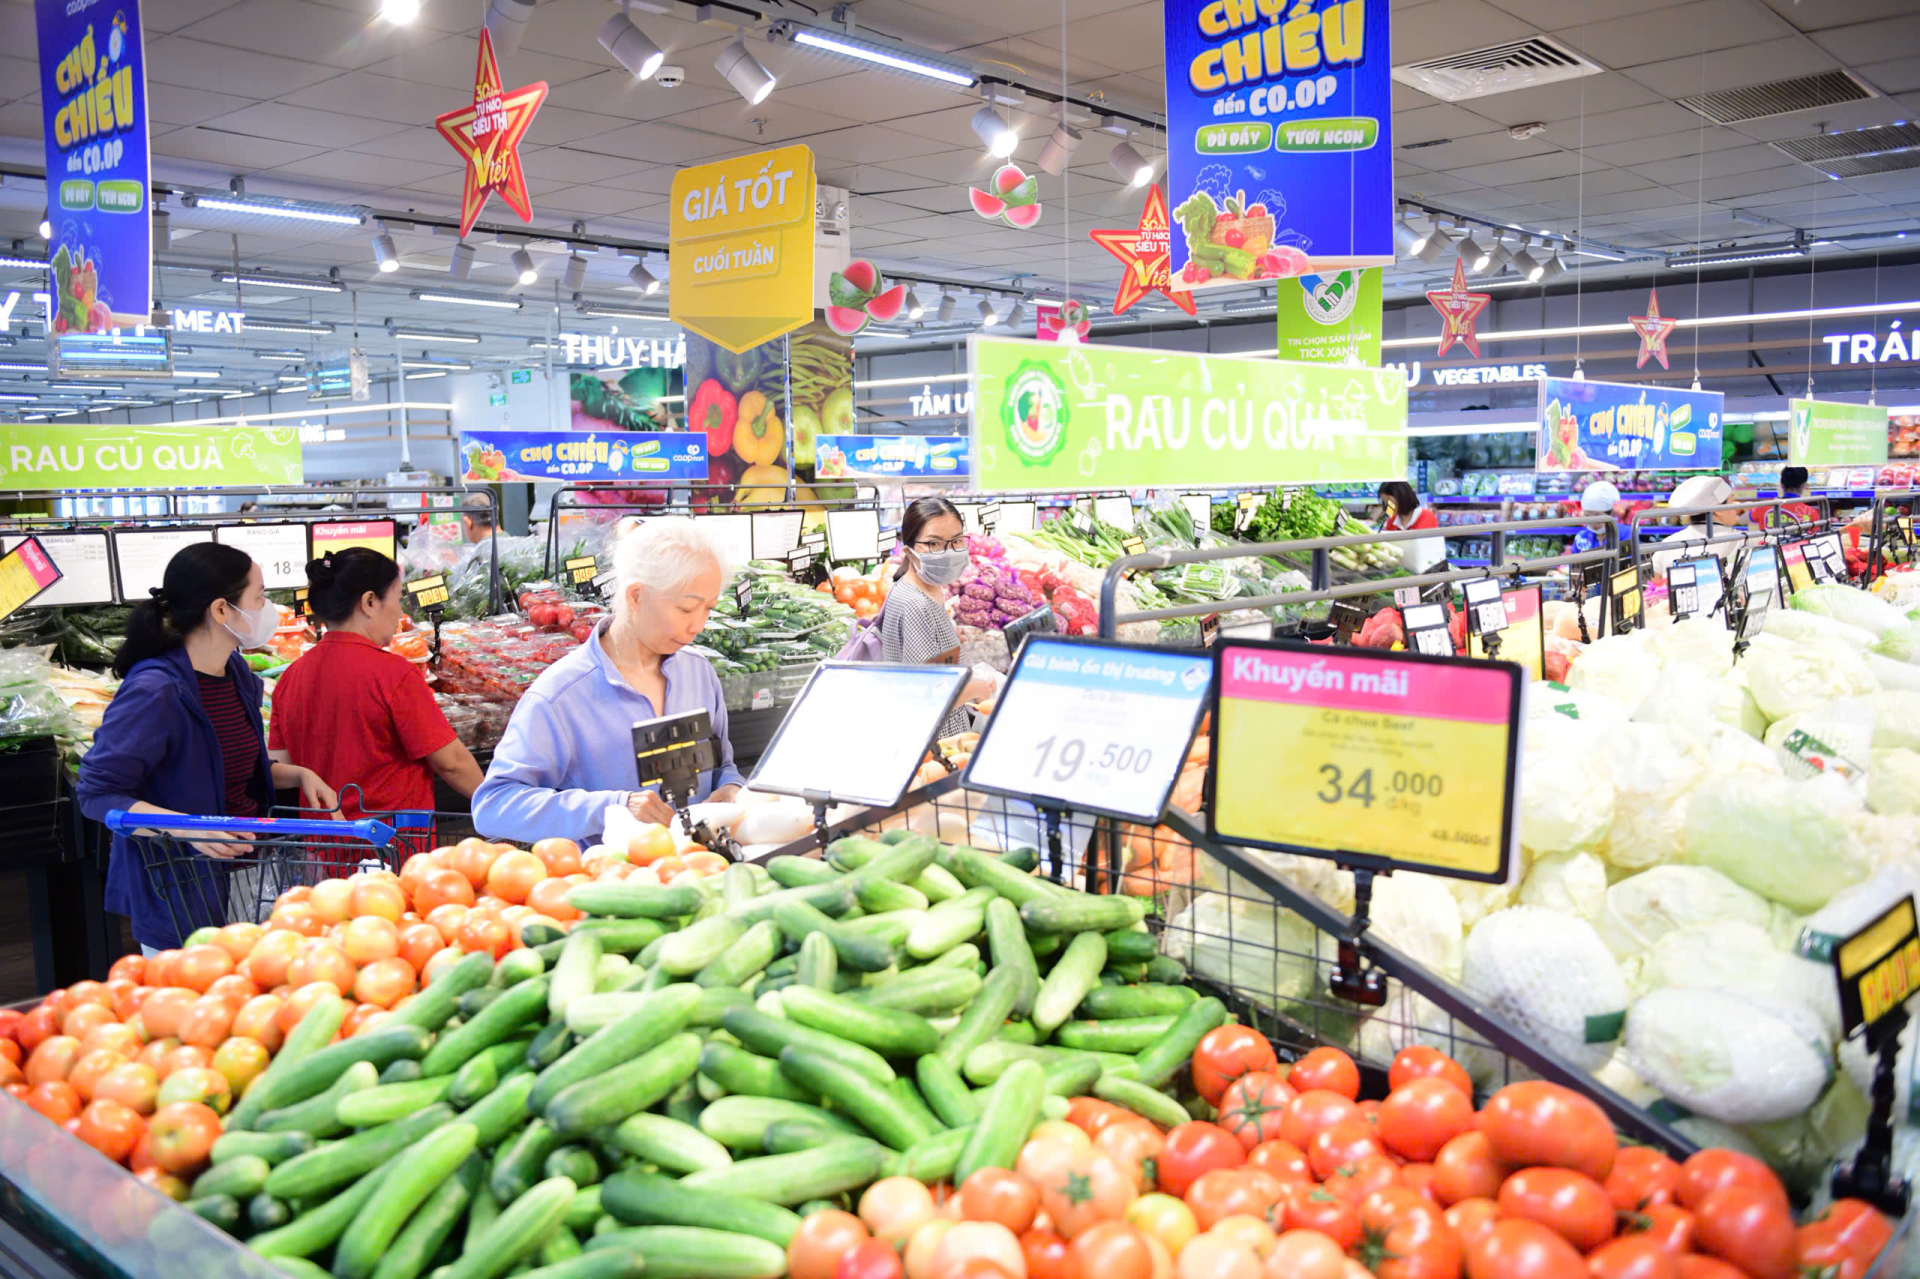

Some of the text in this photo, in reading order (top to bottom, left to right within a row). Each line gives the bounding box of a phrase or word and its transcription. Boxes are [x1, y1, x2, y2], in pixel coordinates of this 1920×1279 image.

[56, 24, 95, 94] CHỢ
[476, 102, 486, 116] TỰ
[1213, 75, 1337, 116] đến CO.OP
[472, 110, 508, 137] SIÊU THỊ
[1286, 128, 1364, 145] TƯƠI NGON
[83, 139, 123, 175] CO.OP
[473, 132, 511, 190] Việt
[683, 160, 793, 222] GIÁ TỐT
[694, 241, 774, 274] CUỐI TUẦN
[1136, 241, 1157, 253] SIÊU
[174, 308, 246, 334] MEAT
[559, 326, 646, 368] THỦY
[1300, 347, 1325, 359] TICK
[1433, 364, 1548, 386] VEGETABLES
[1105, 394, 1191, 451] RAU
[1201, 382, 1255, 450] CỦ
[1263, 388, 1336, 451] QUẢ
[10, 434, 225, 472] RAU CỦ QUẢ
[521, 443, 553, 463] CHỢ
[561, 462, 593, 475] CO.OP
[1233, 656, 1409, 696] Khuyến mãi
